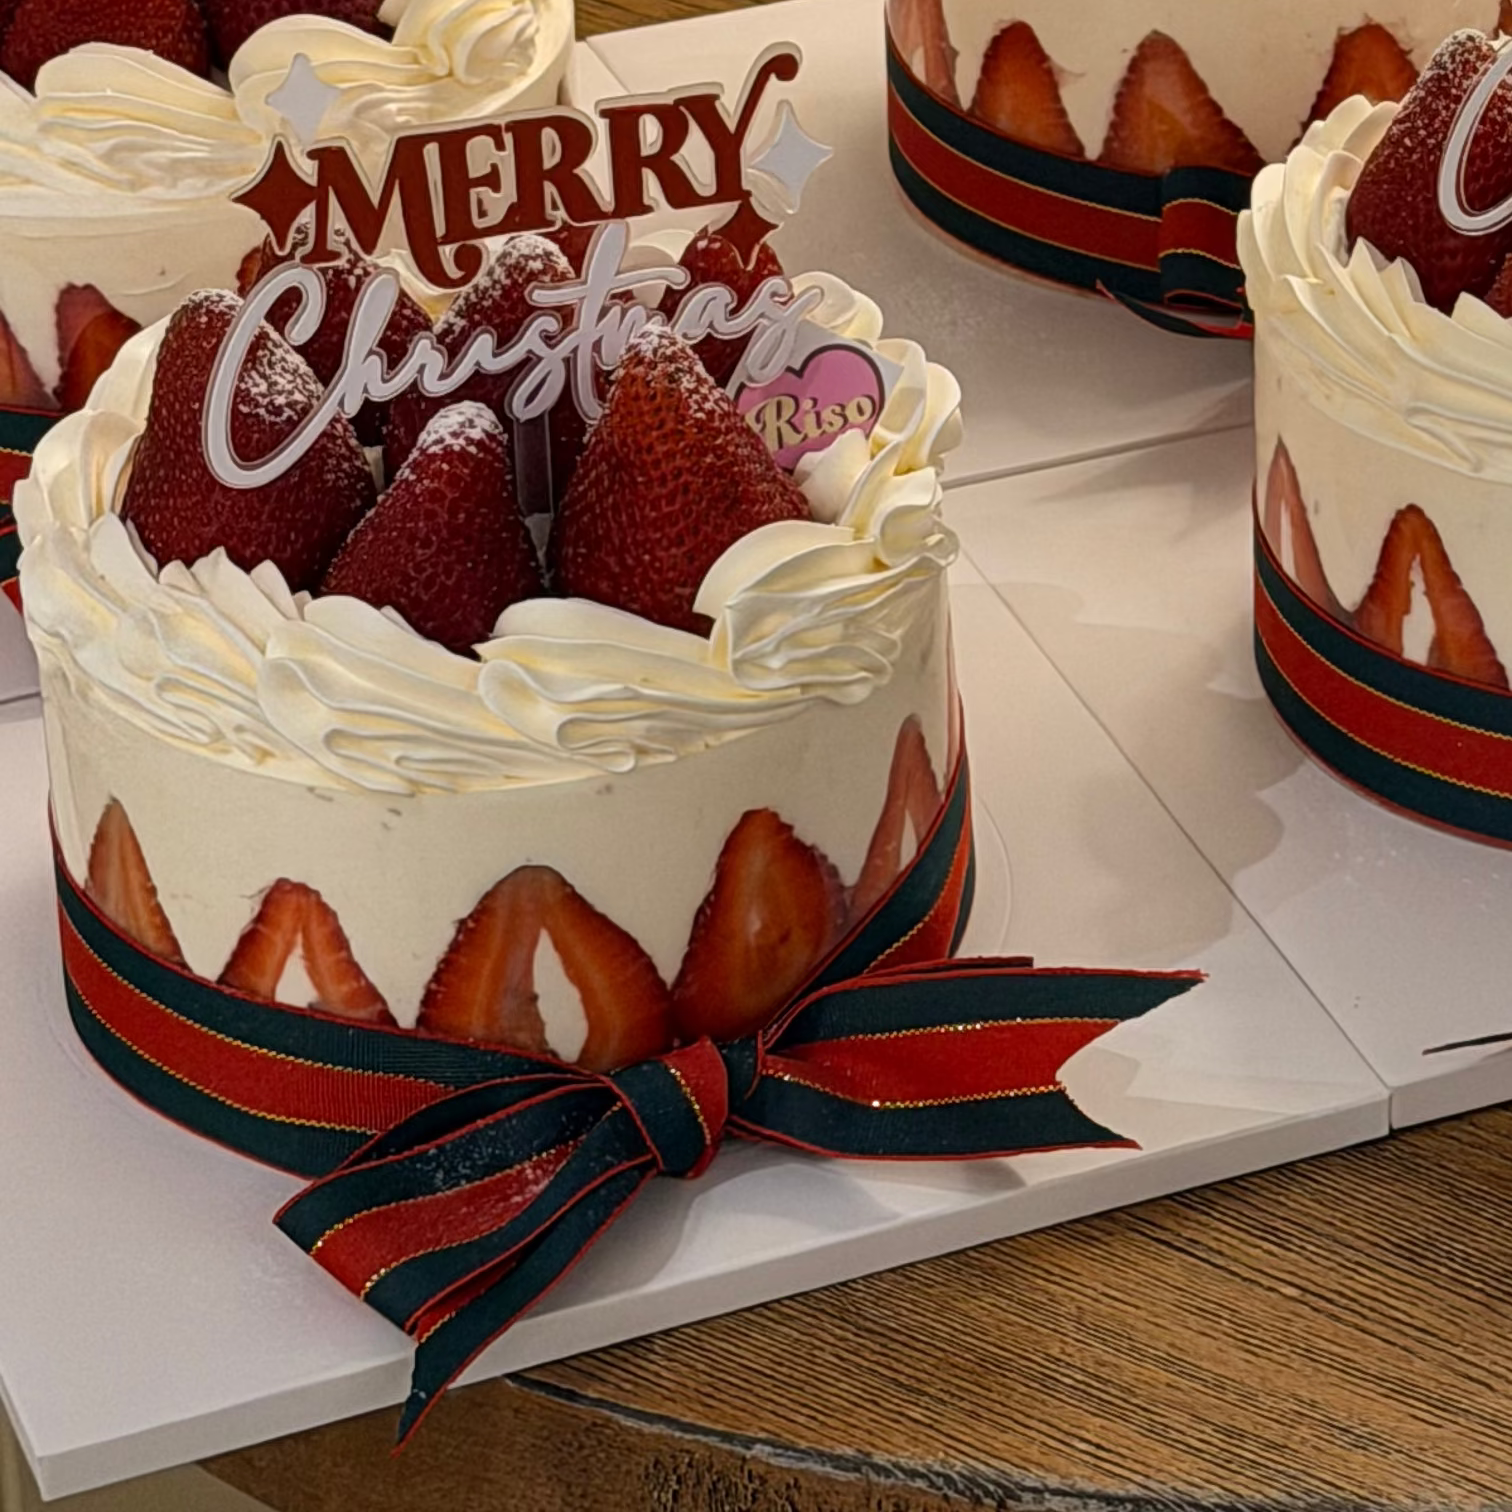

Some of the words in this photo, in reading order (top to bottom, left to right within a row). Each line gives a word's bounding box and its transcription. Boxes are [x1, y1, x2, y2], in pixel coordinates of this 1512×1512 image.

[304, 51, 800, 283] MERRY
[208, 221, 825, 487] Christmas
[744, 394, 876, 456] Riso
